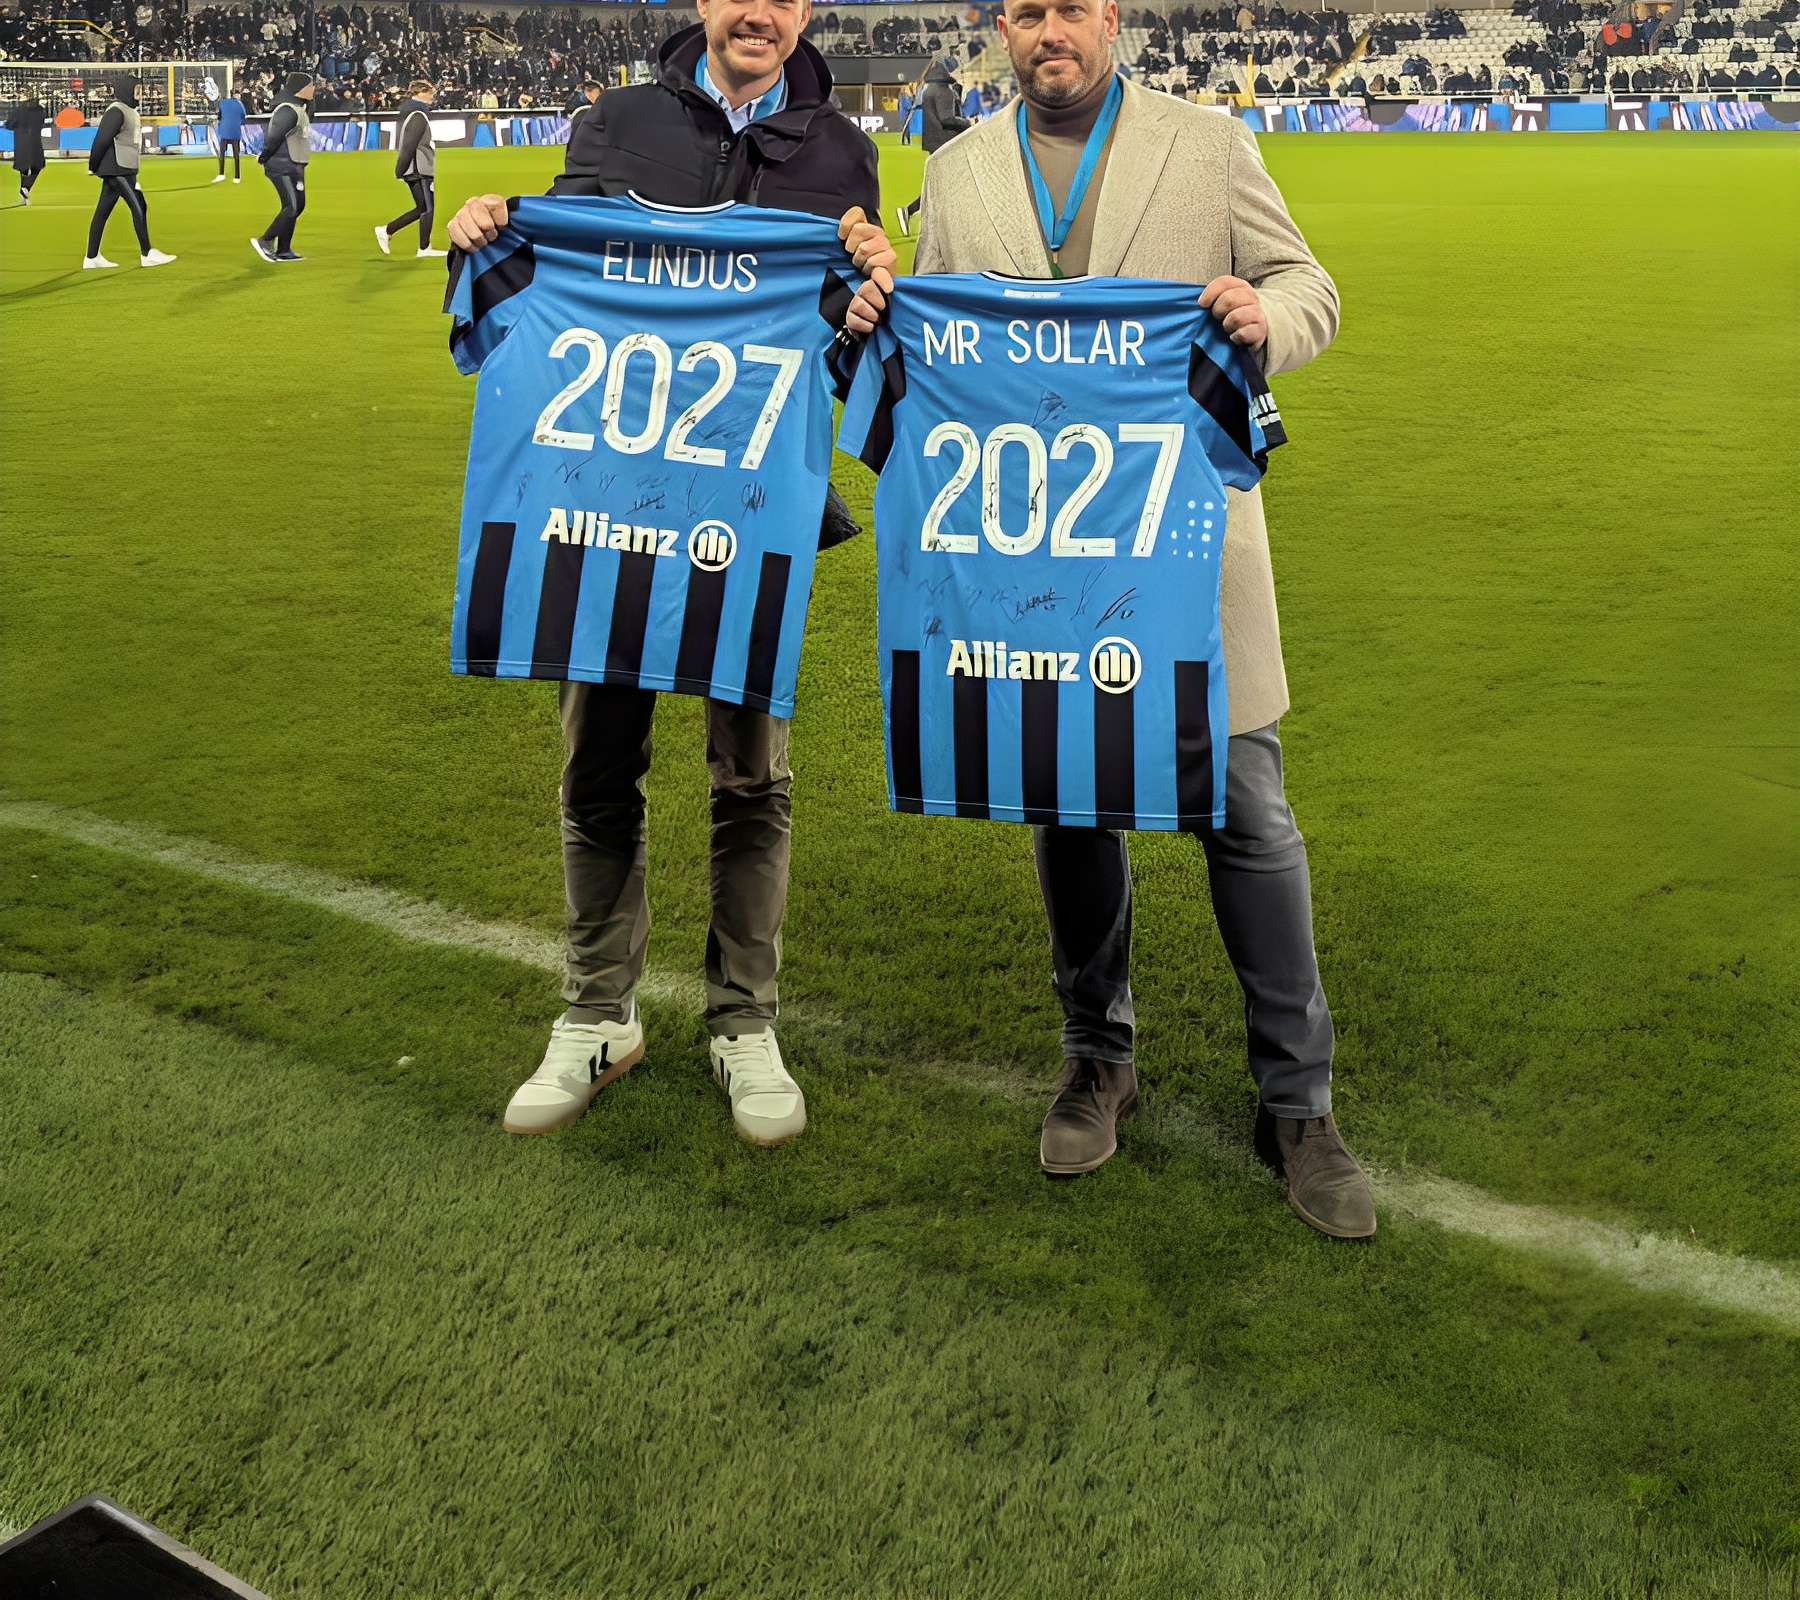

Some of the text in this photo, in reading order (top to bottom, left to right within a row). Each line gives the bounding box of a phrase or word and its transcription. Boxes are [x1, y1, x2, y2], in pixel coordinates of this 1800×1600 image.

[602, 240, 759, 293] ELINDUS
[922, 319, 1146, 367] MR SOLAR
[531, 326, 805, 471] 2027
[920, 420, 1185, 558] 2027
[539, 506, 680, 557] Allianz
[945, 638, 1081, 682] Allianz
